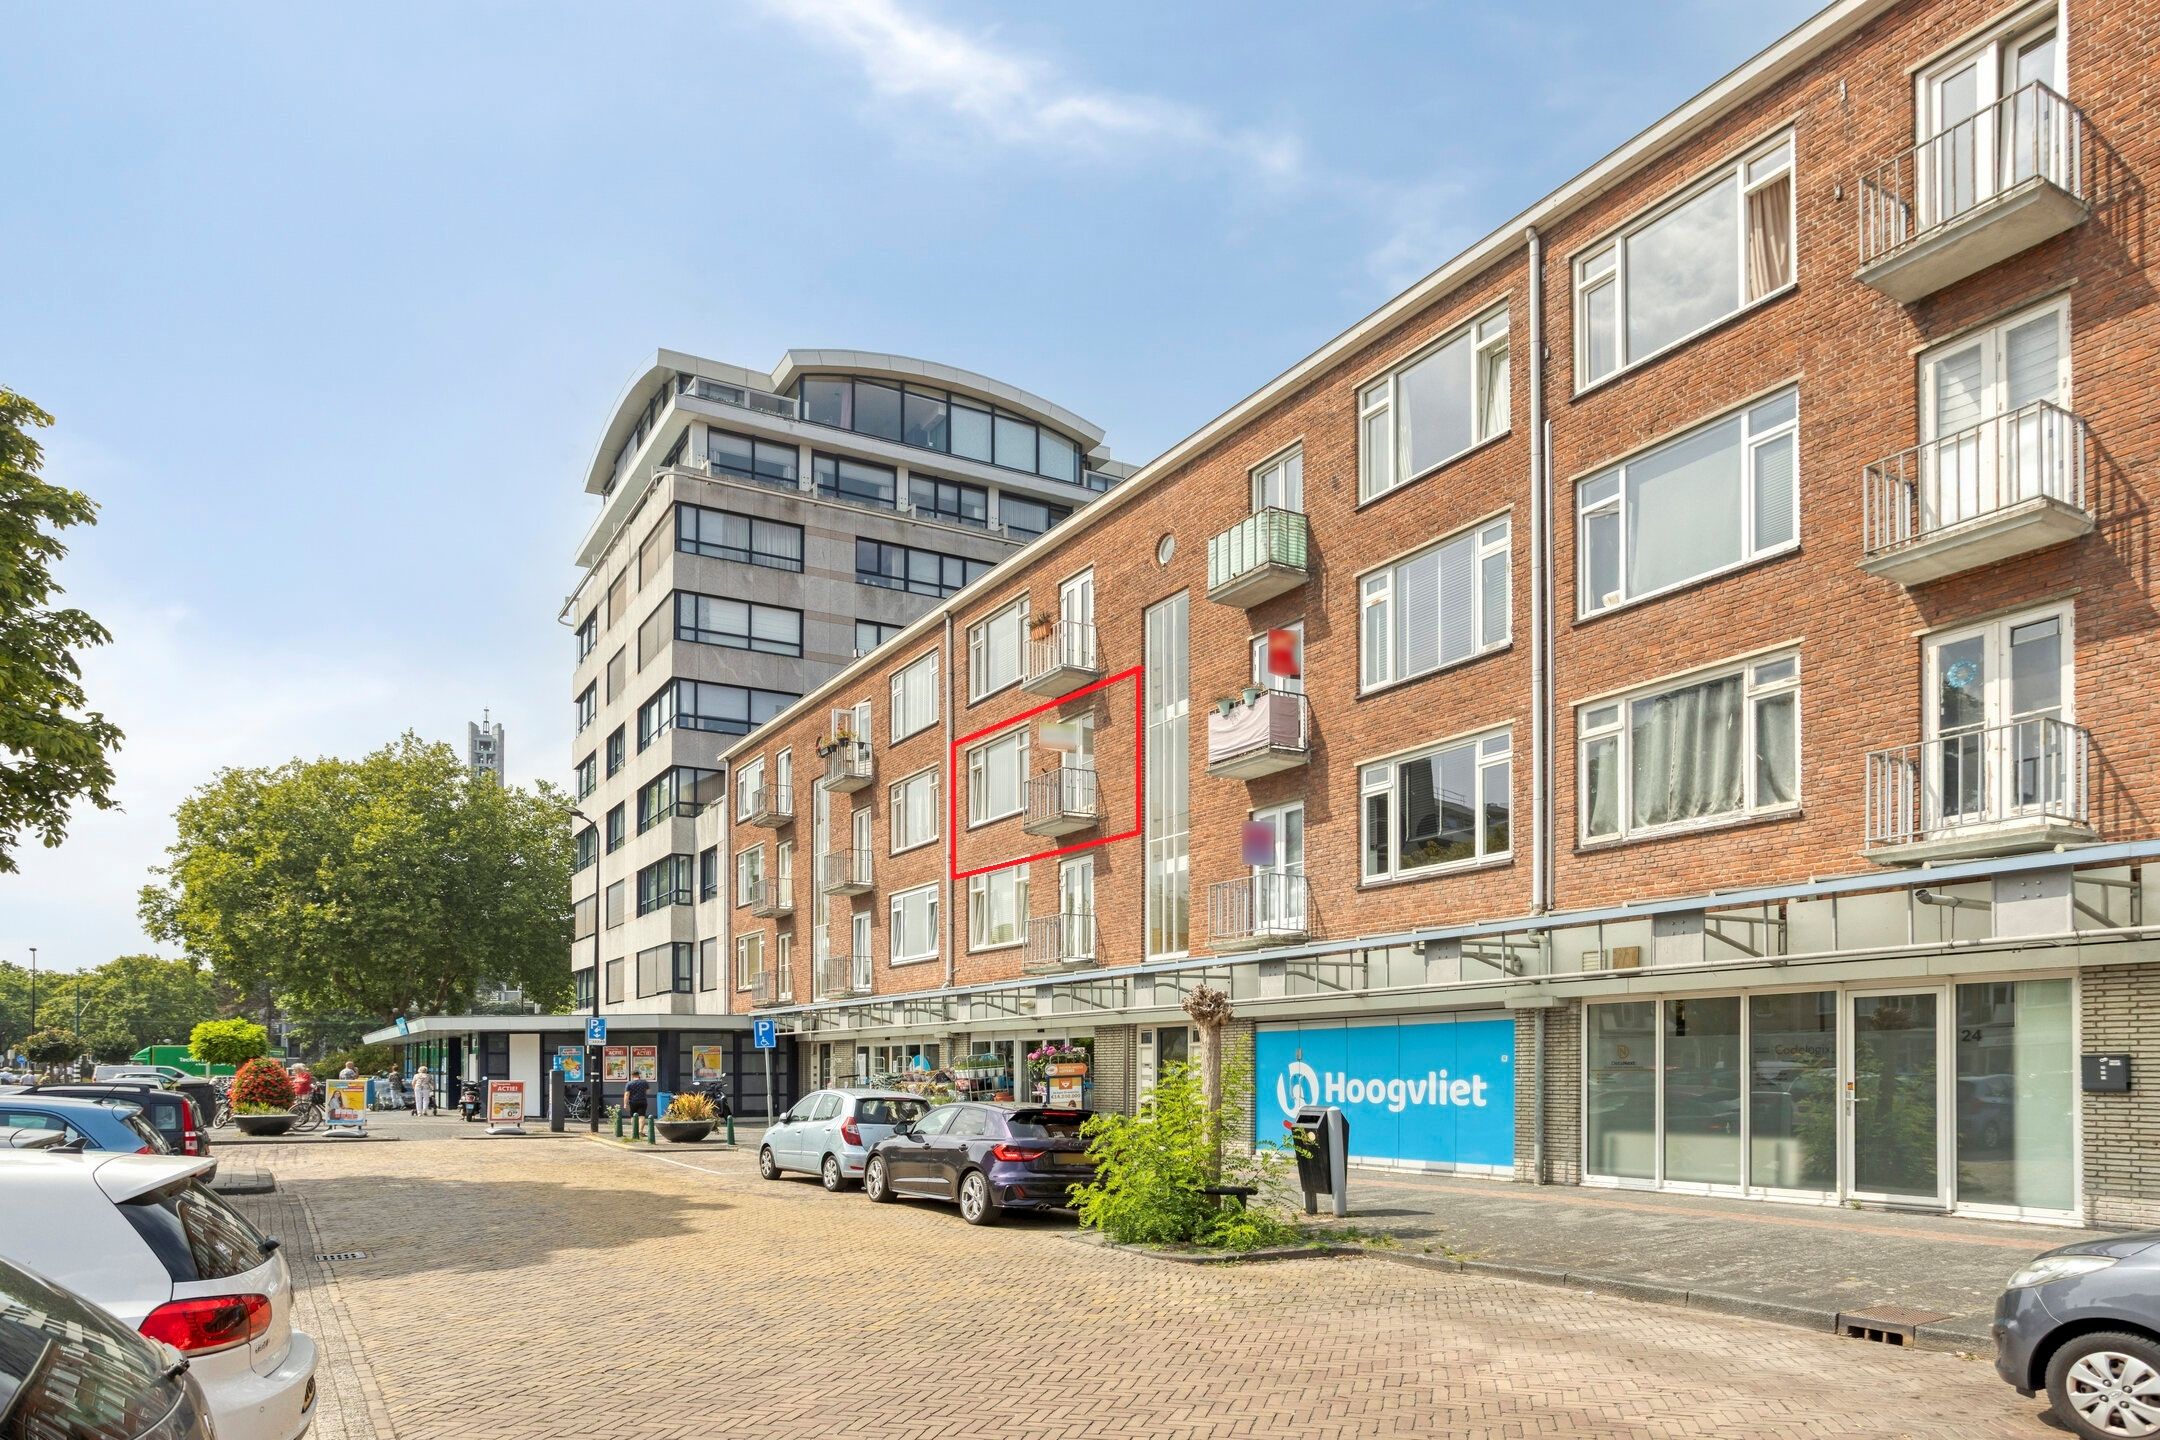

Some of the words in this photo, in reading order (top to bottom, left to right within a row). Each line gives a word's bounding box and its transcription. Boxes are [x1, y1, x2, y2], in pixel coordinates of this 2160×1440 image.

[591, 1020, 599, 1029] P
[759, 1022, 770, 1036] P
[1961, 1030, 1982, 1042] 24
[1325, 1069, 1488, 1113] Hoogvliet
